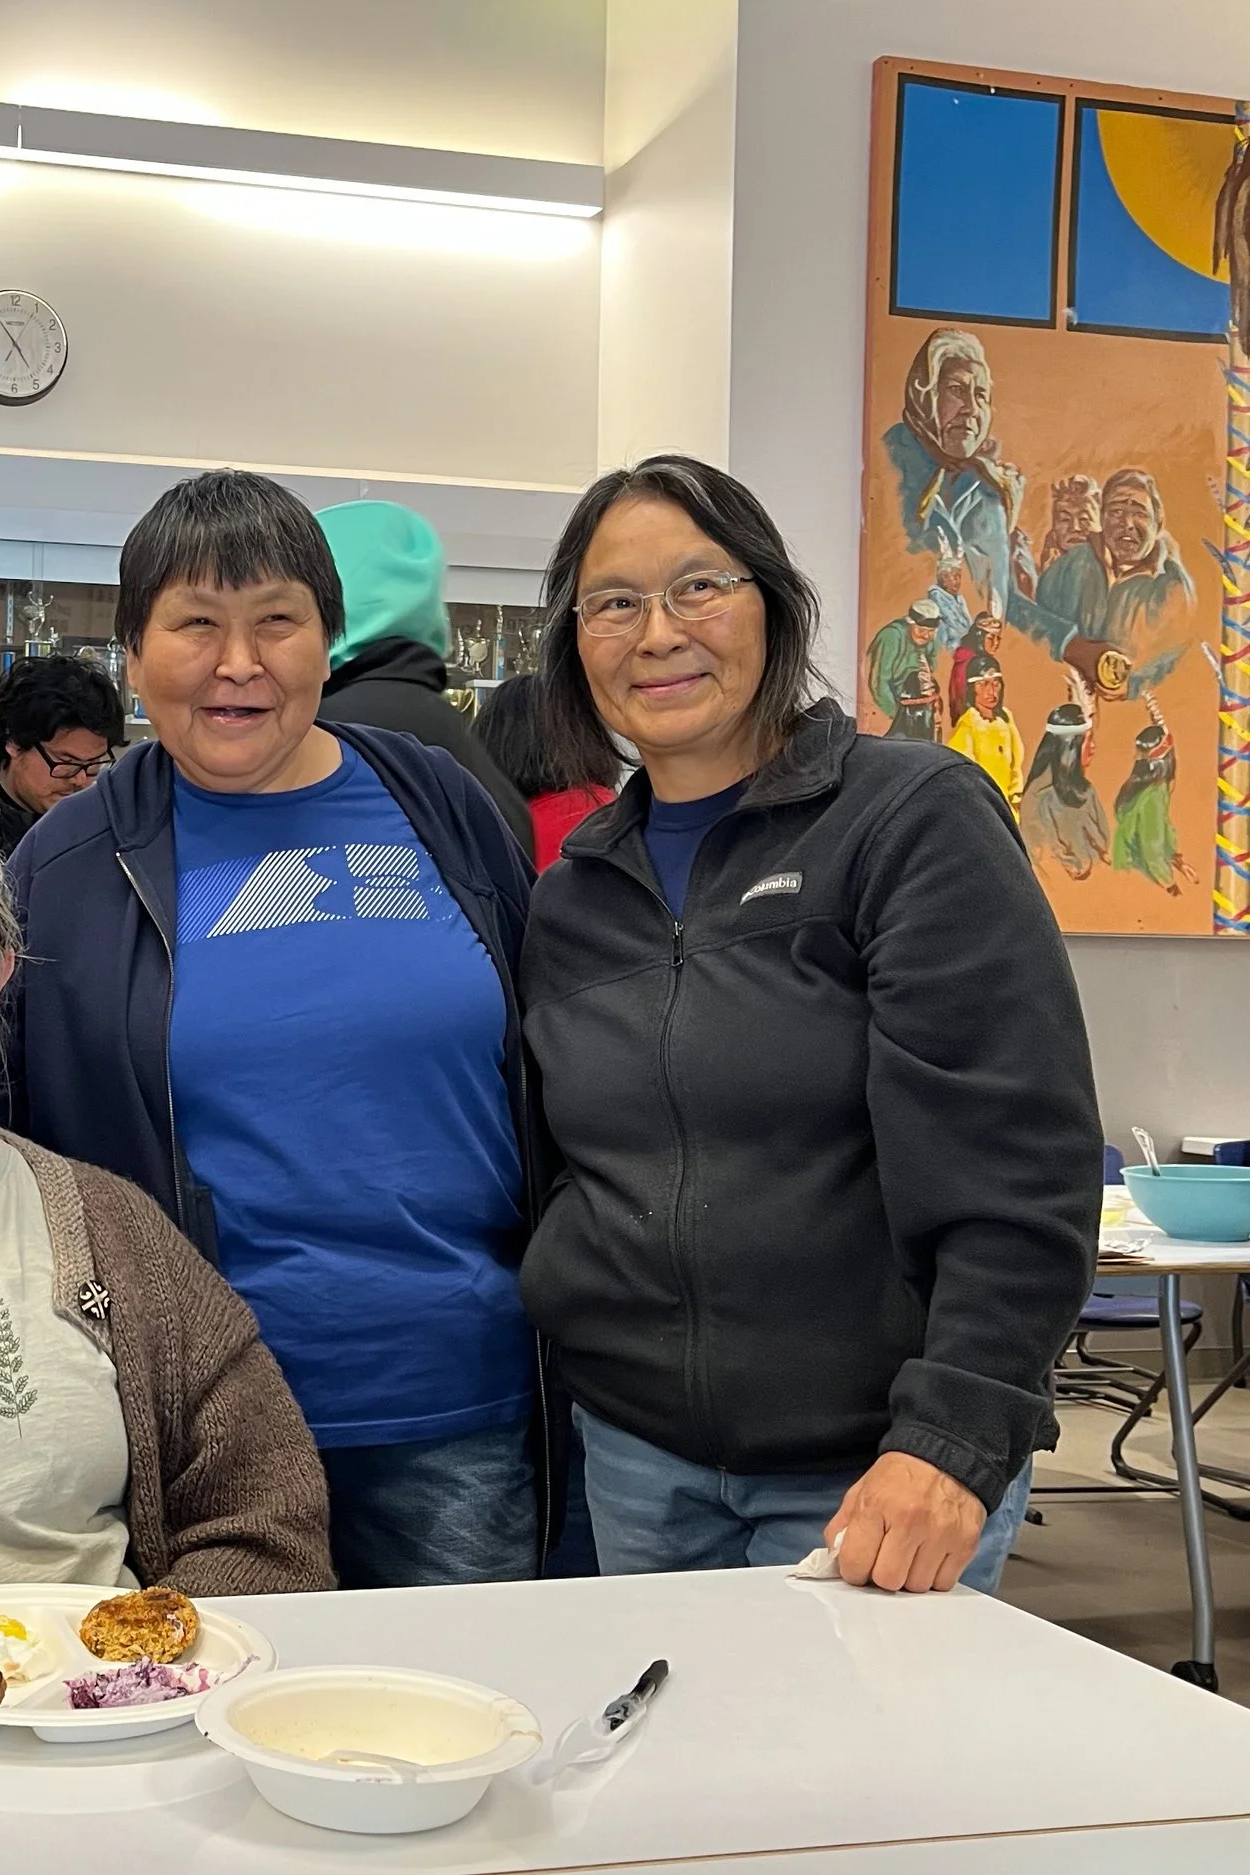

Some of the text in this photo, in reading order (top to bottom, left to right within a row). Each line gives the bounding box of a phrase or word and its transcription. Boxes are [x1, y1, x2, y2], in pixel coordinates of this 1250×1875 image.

[11, 295, 21, 306] 12
[34, 303, 39, 313] 1
[49, 319, 56, 331] 2
[54, 342, 61, 353] 3
[47, 364, 53, 375] 4
[11, 383, 18, 394] 6
[32, 379, 40, 390] 5
